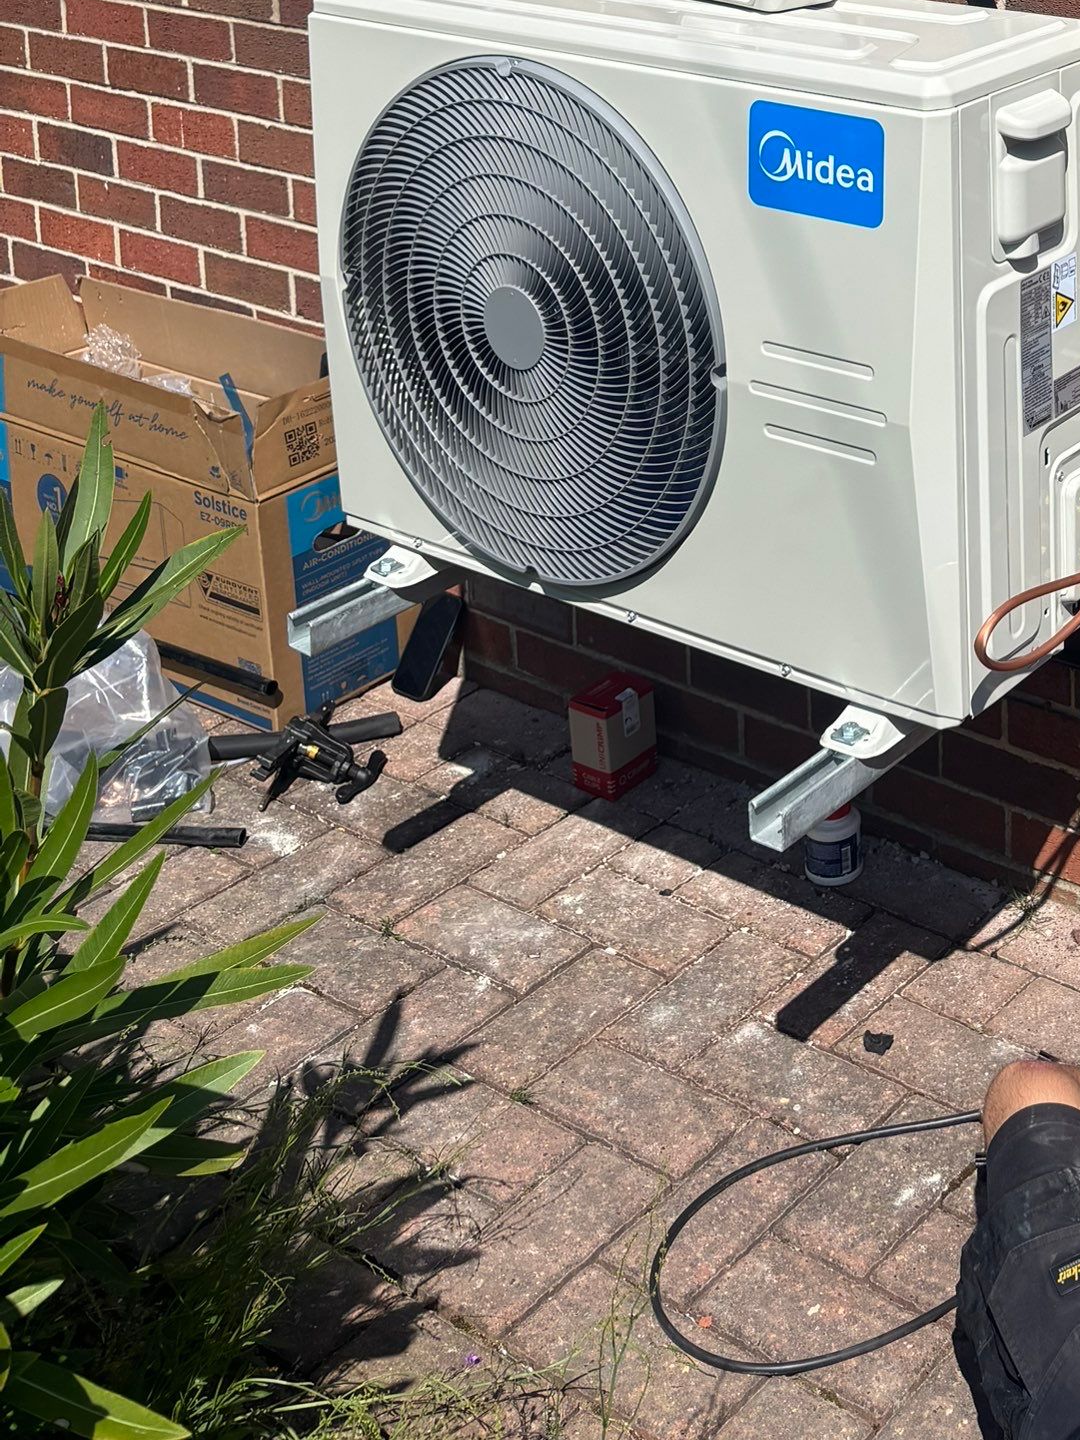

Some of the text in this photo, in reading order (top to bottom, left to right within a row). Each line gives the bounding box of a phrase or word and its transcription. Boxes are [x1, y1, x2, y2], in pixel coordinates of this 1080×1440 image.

[758, 129, 874, 193] Midea
[26, 378, 189, 440] make yourelf at home
[194, 490, 248, 521] Solstice
[303, 533, 377, 570] AIR-CONDITIONE
[215, 575, 259, 595] EUROVENT
